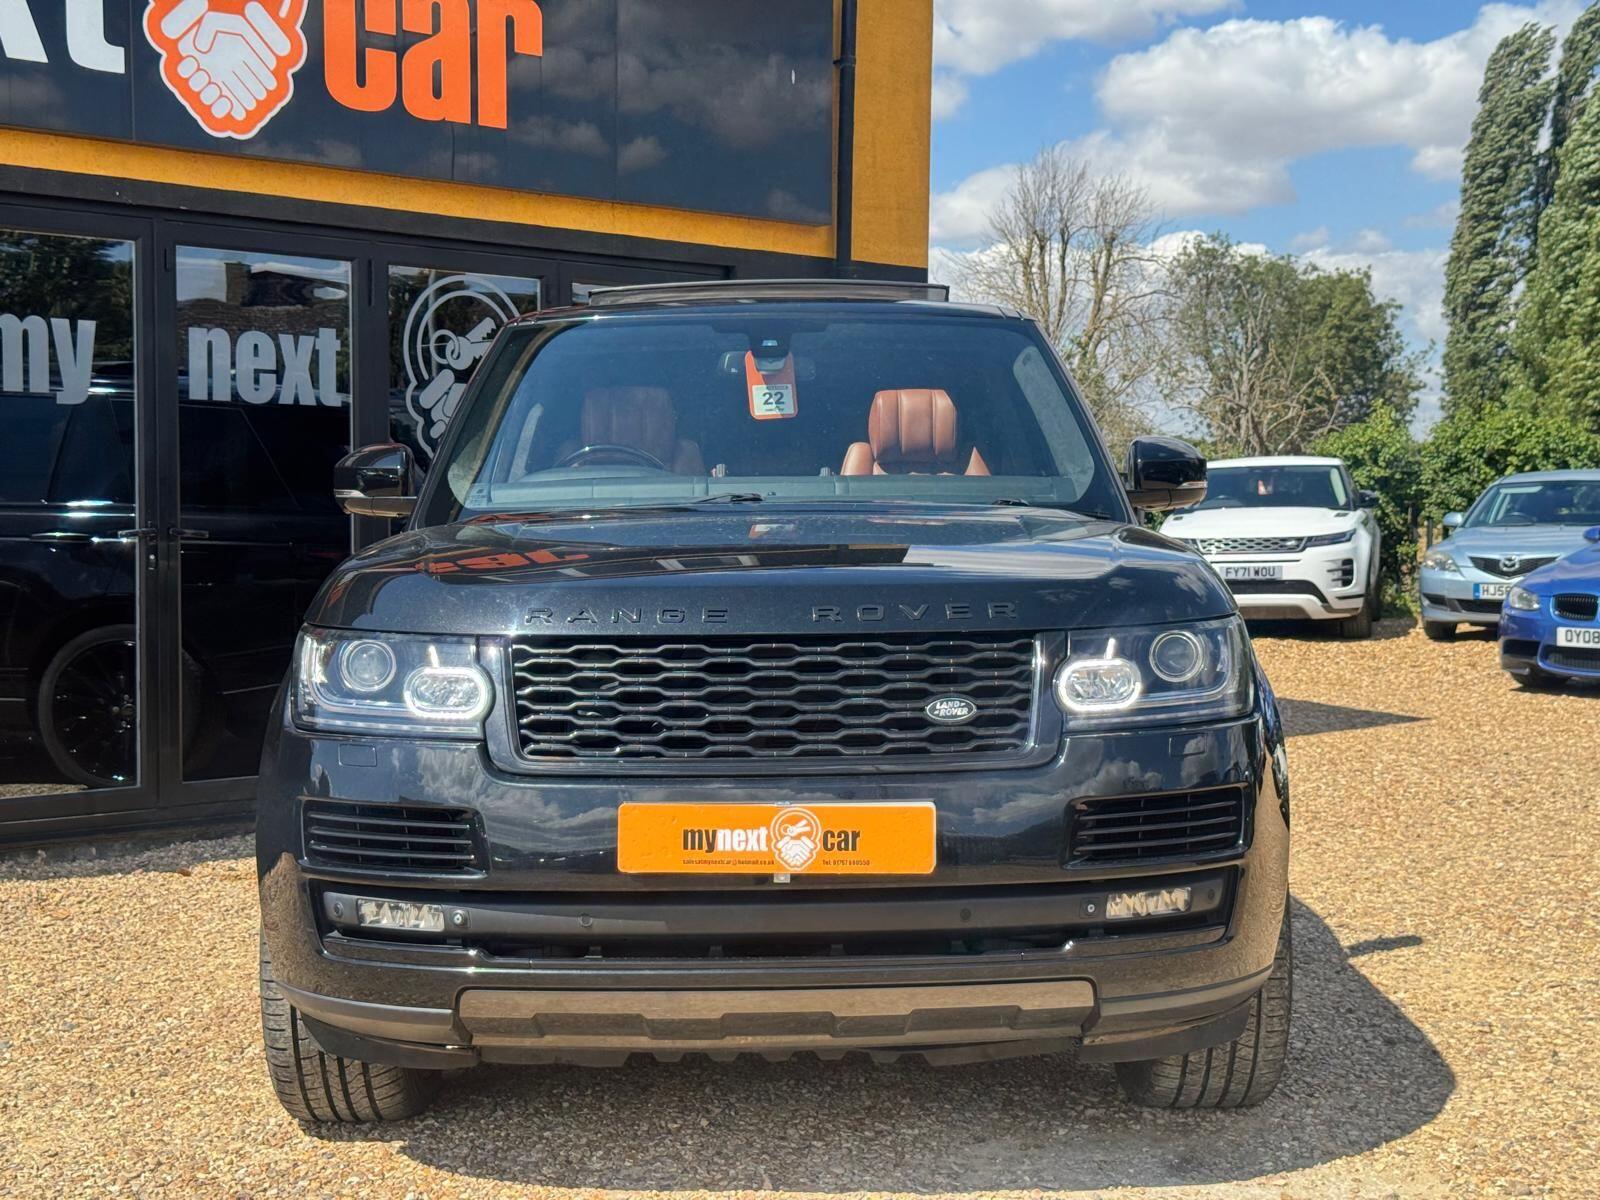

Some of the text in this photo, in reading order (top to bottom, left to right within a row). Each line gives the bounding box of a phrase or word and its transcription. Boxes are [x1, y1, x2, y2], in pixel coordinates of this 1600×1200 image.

[323, 0, 543, 129] car
[0, 313, 342, 407] my next
[762, 391, 785, 406] 22
[1225, 566, 1276, 577] FY71 WOU
[525, 602, 1018, 624] RANGE ROVER
[823, 829, 861, 852] car
